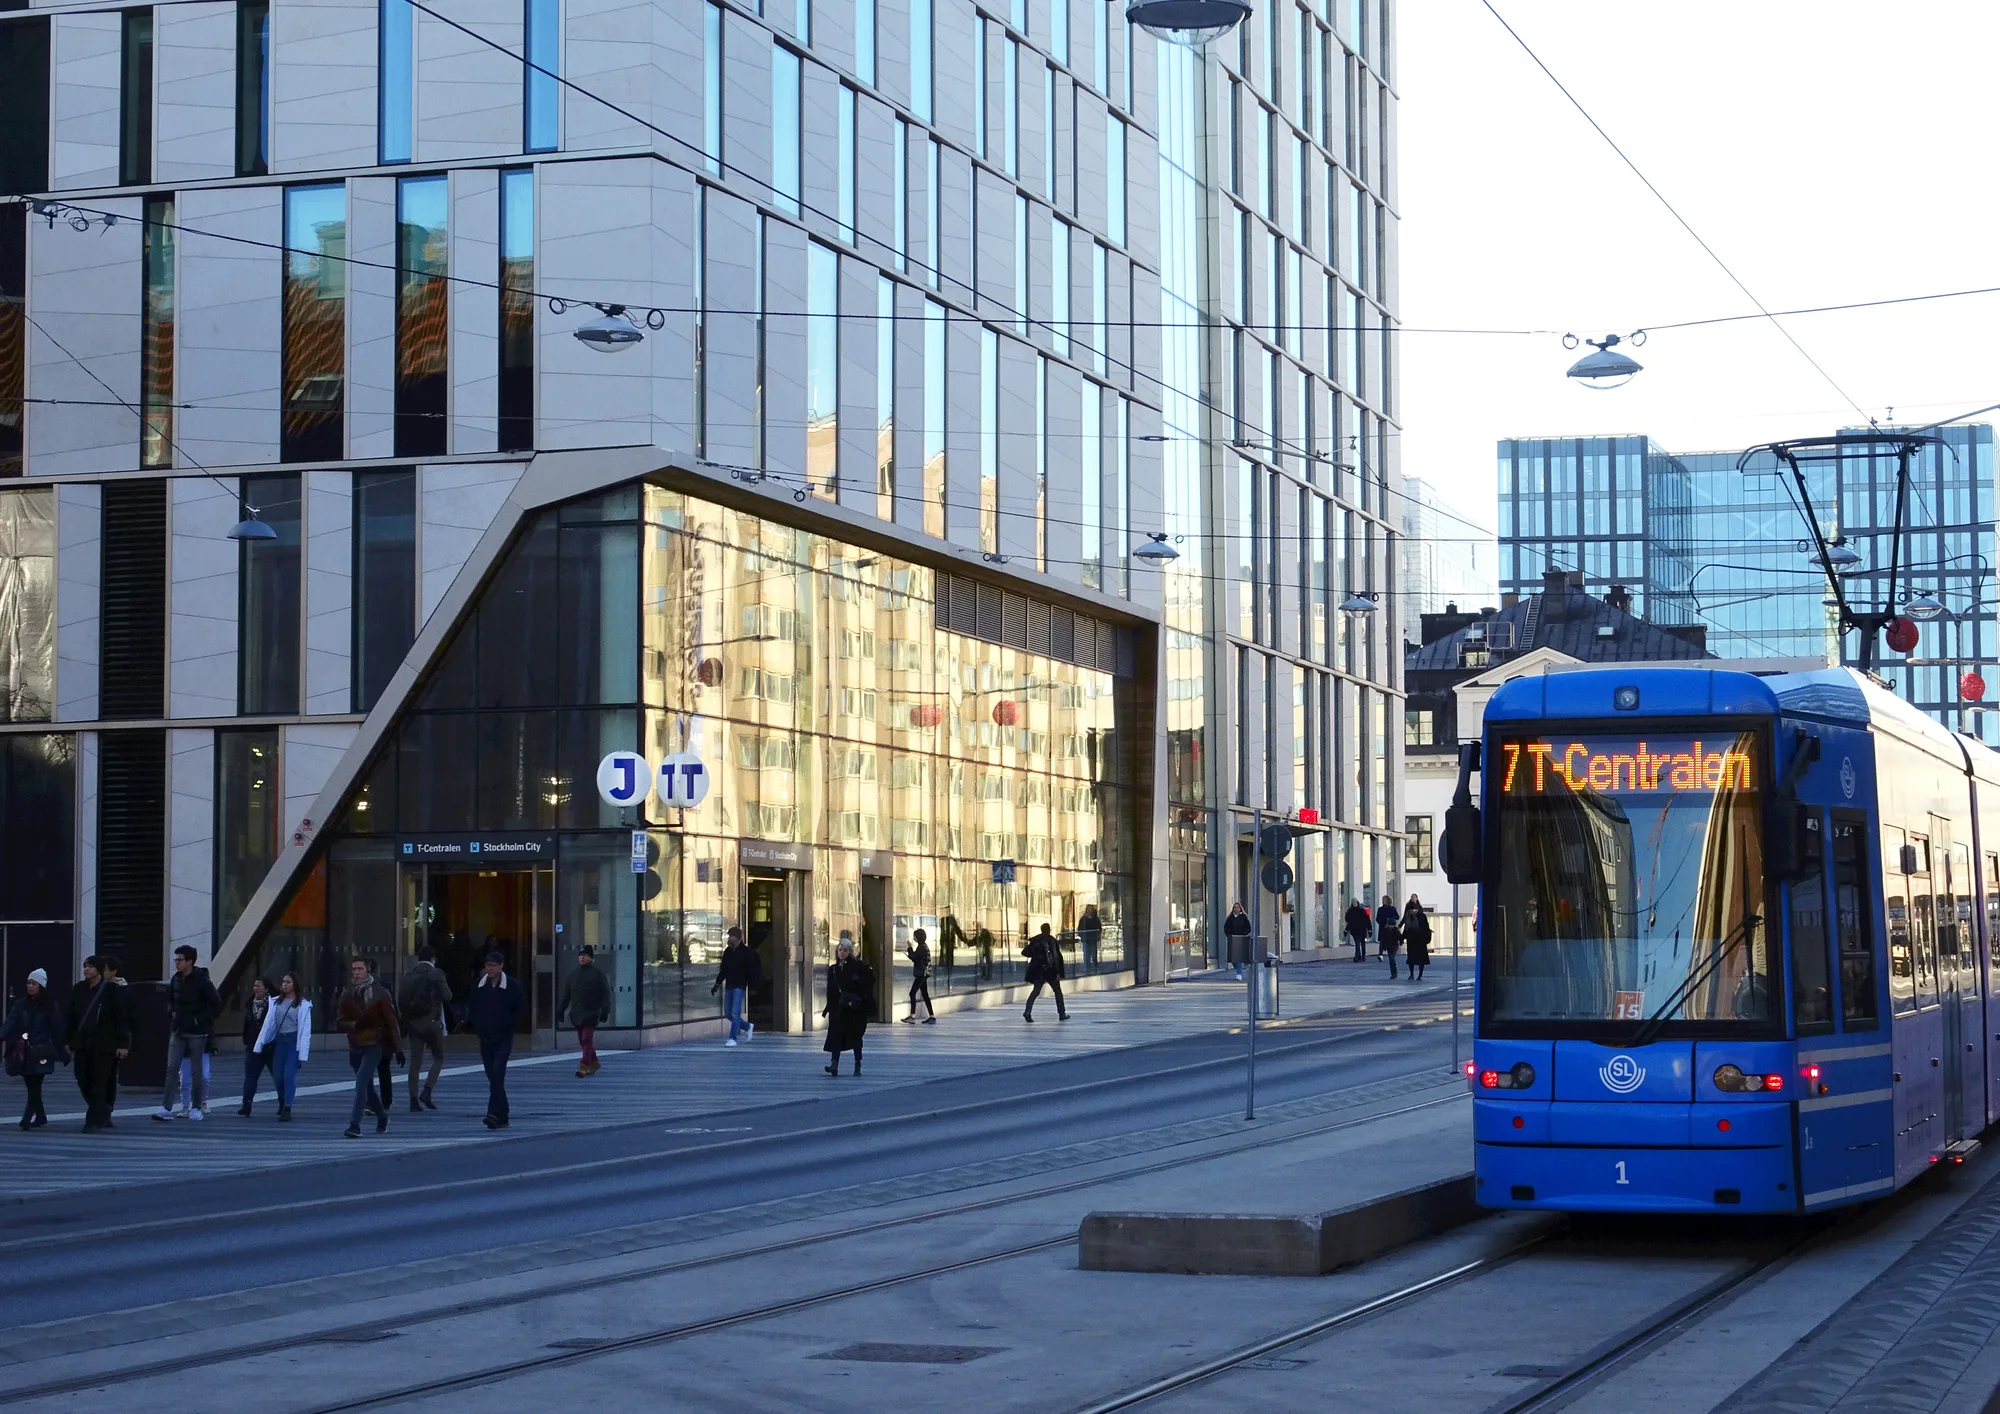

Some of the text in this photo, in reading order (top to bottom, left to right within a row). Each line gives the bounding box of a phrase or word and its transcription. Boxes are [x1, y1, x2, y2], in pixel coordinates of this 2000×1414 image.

[1504, 741, 1751, 791] 7 T-Centralen
[609, 758, 636, 800] J
[416, 844, 461, 853] T-Centralen
[483, 842, 541, 853] Stockholm City
[1617, 1003, 1640, 1019] 15
[1612, 1062, 1633, 1077] SL
[1614, 1160, 1630, 1185] 1
